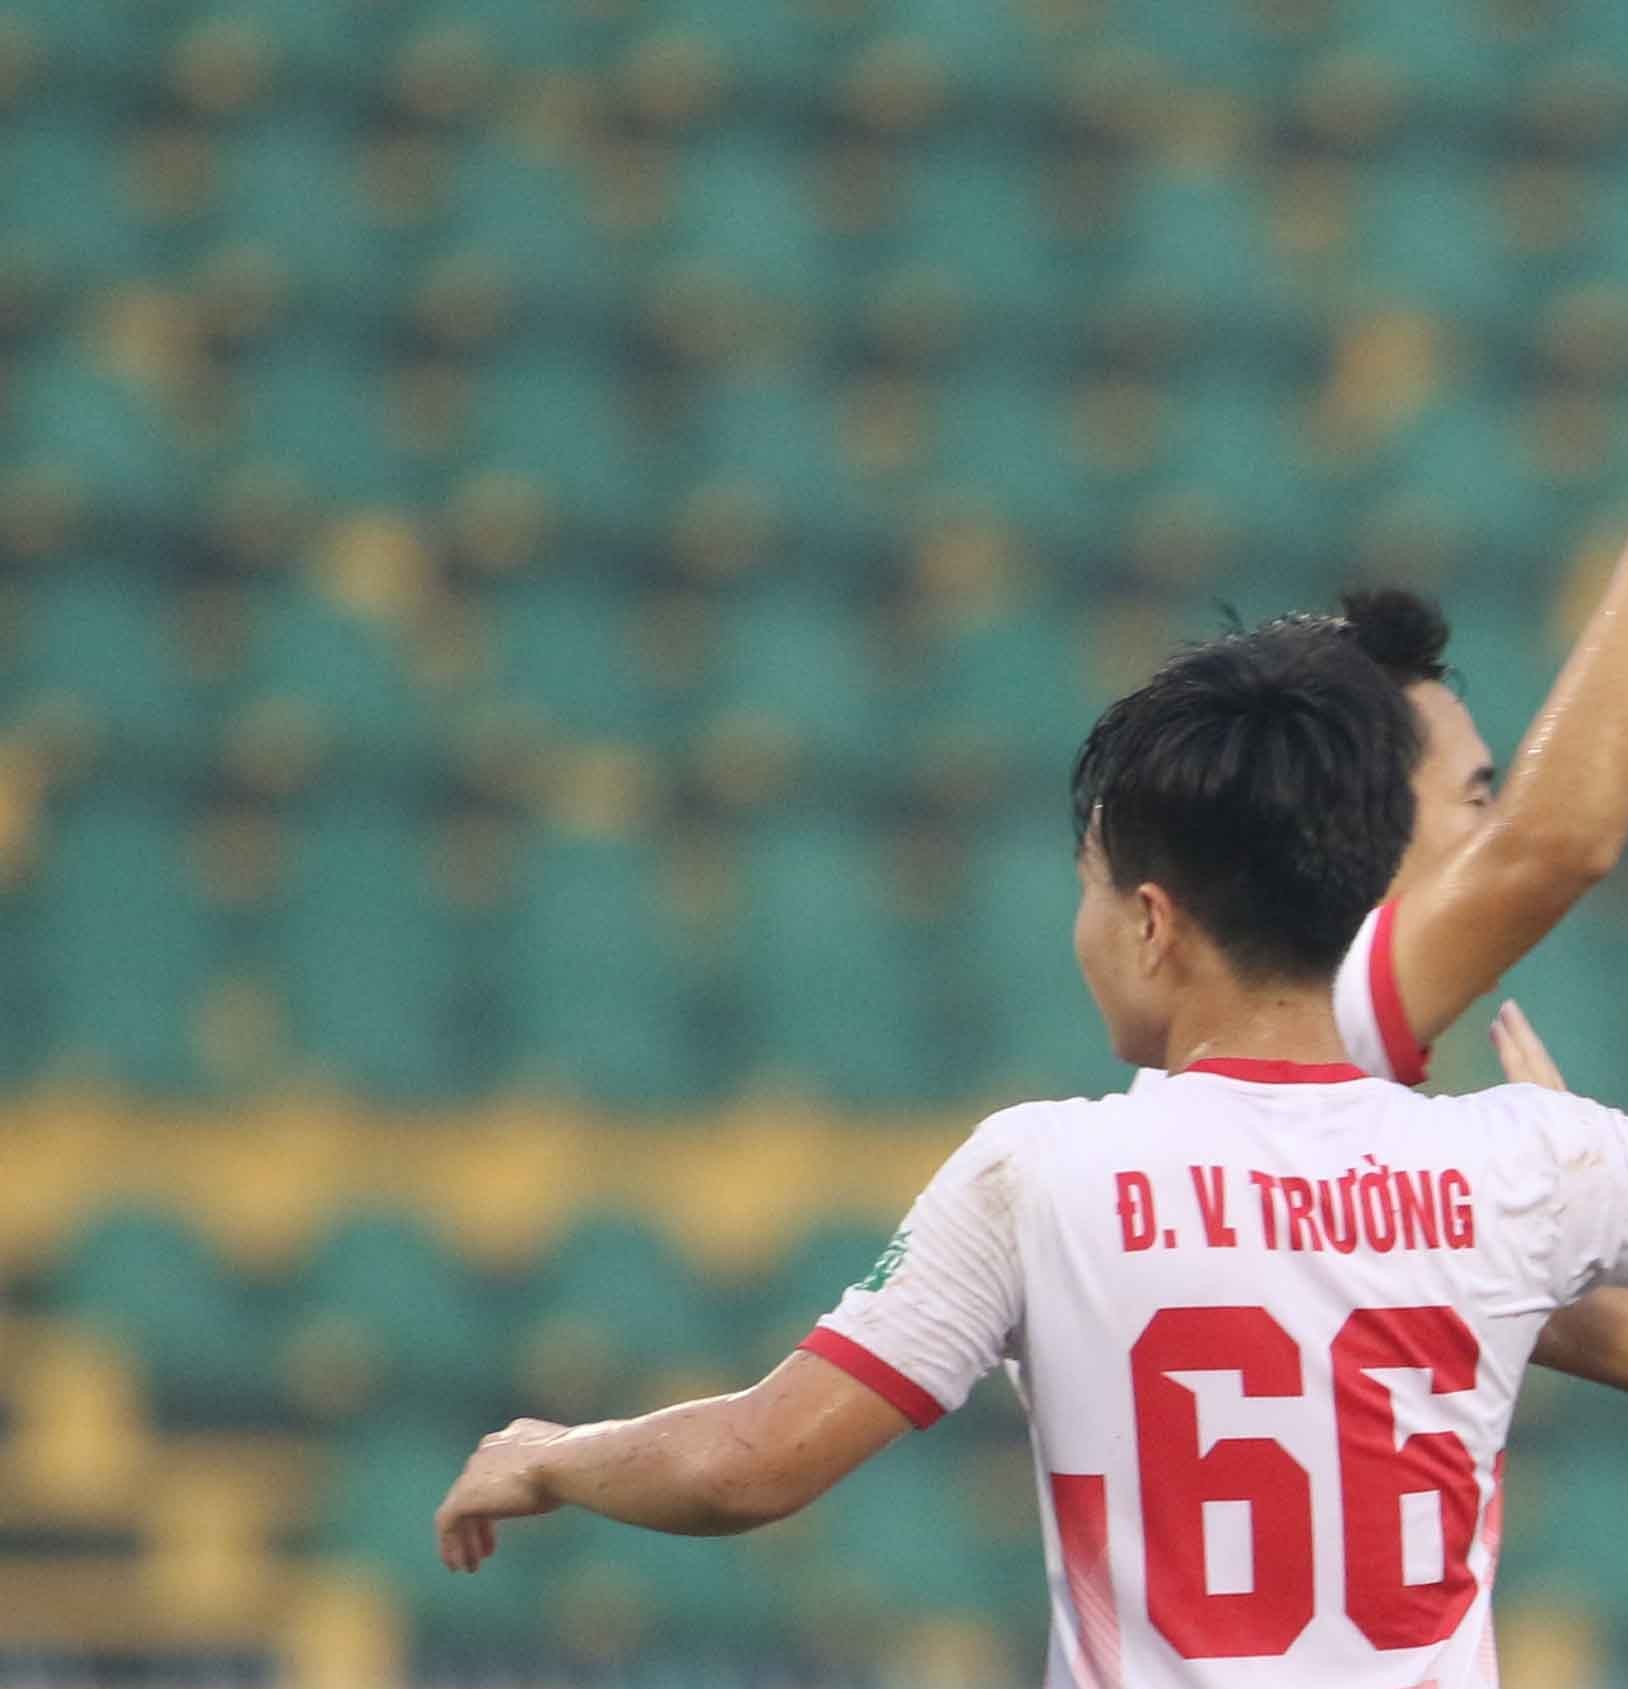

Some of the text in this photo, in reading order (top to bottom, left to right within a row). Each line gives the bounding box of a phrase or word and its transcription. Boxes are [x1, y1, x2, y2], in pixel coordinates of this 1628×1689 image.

[1114, 1170, 1177, 1252] Đ.
[1248, 1153, 1475, 1254] TRƯỜNG
[1129, 1305, 1482, 1661] 66
